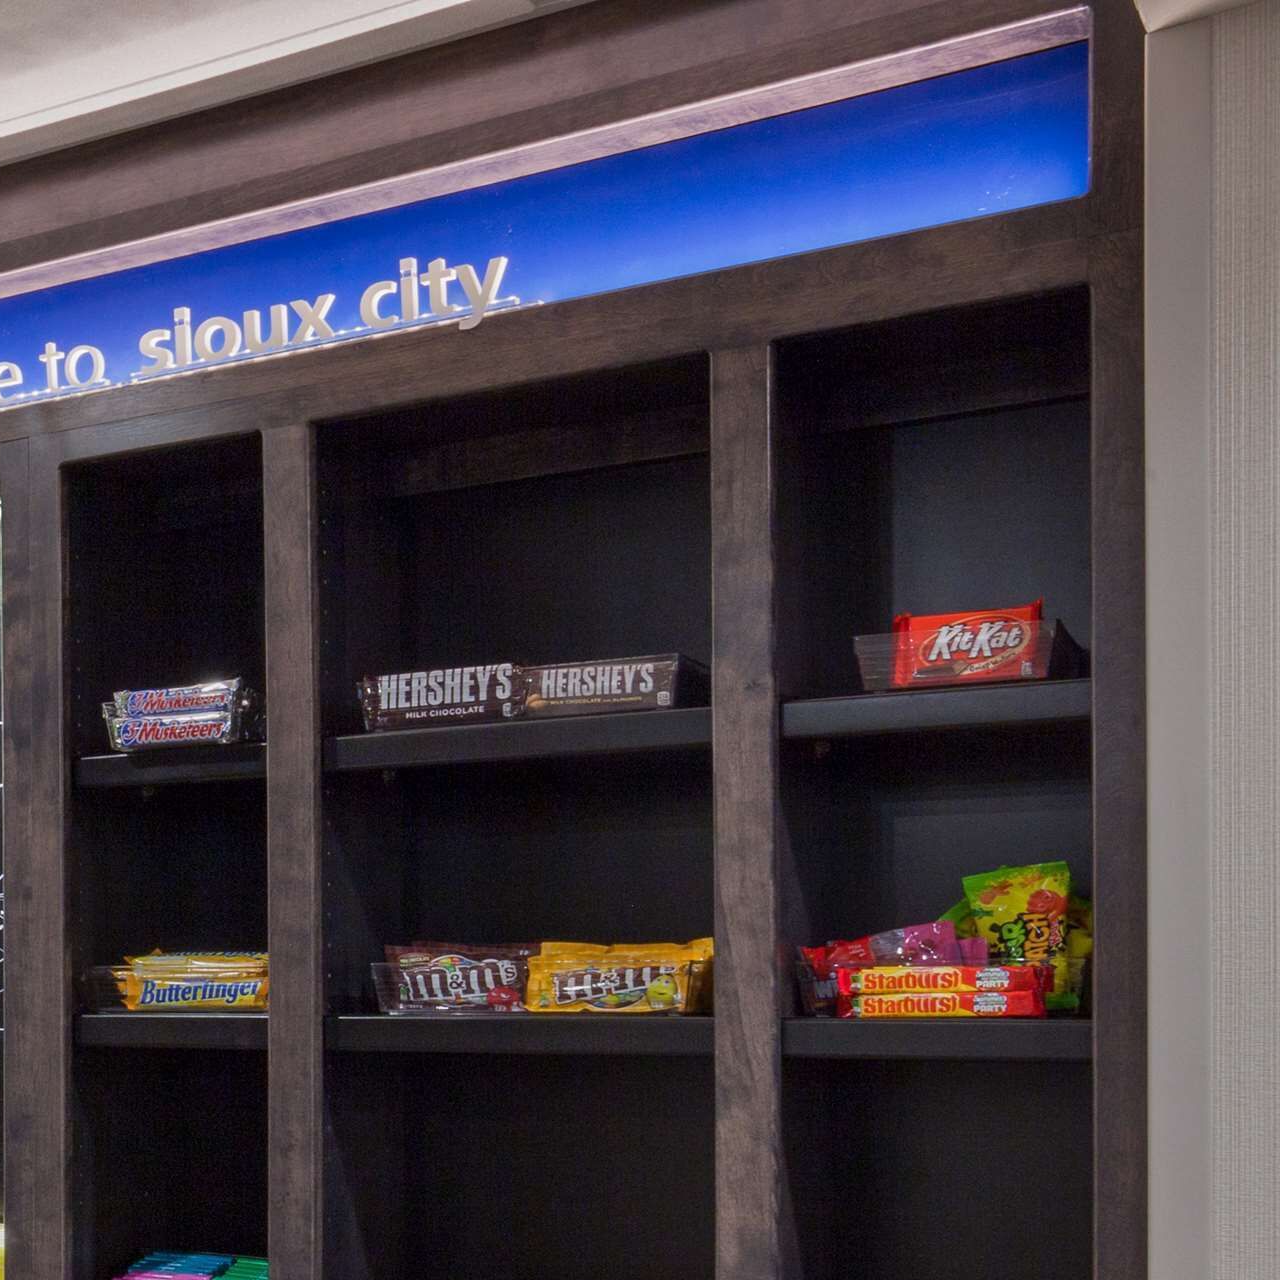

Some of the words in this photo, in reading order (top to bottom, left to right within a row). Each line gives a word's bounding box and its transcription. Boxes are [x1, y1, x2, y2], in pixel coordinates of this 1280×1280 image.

[40, 341, 106, 391] to
[139, 294, 336, 377] sioux
[359, 256, 509, 331] city
[379, 663, 512, 709] HERSHEY'S
[541, 663, 654, 699] HERSHEY'S
[405, 710, 427, 719] MILK
[429, 706, 485, 717] CHOCOLATE
[139, 720, 225, 743] Musketeers
[141, 979, 262, 1004] Butterfinger
[863, 969, 960, 990] Starburst
[863, 994, 959, 1015] Starburst
